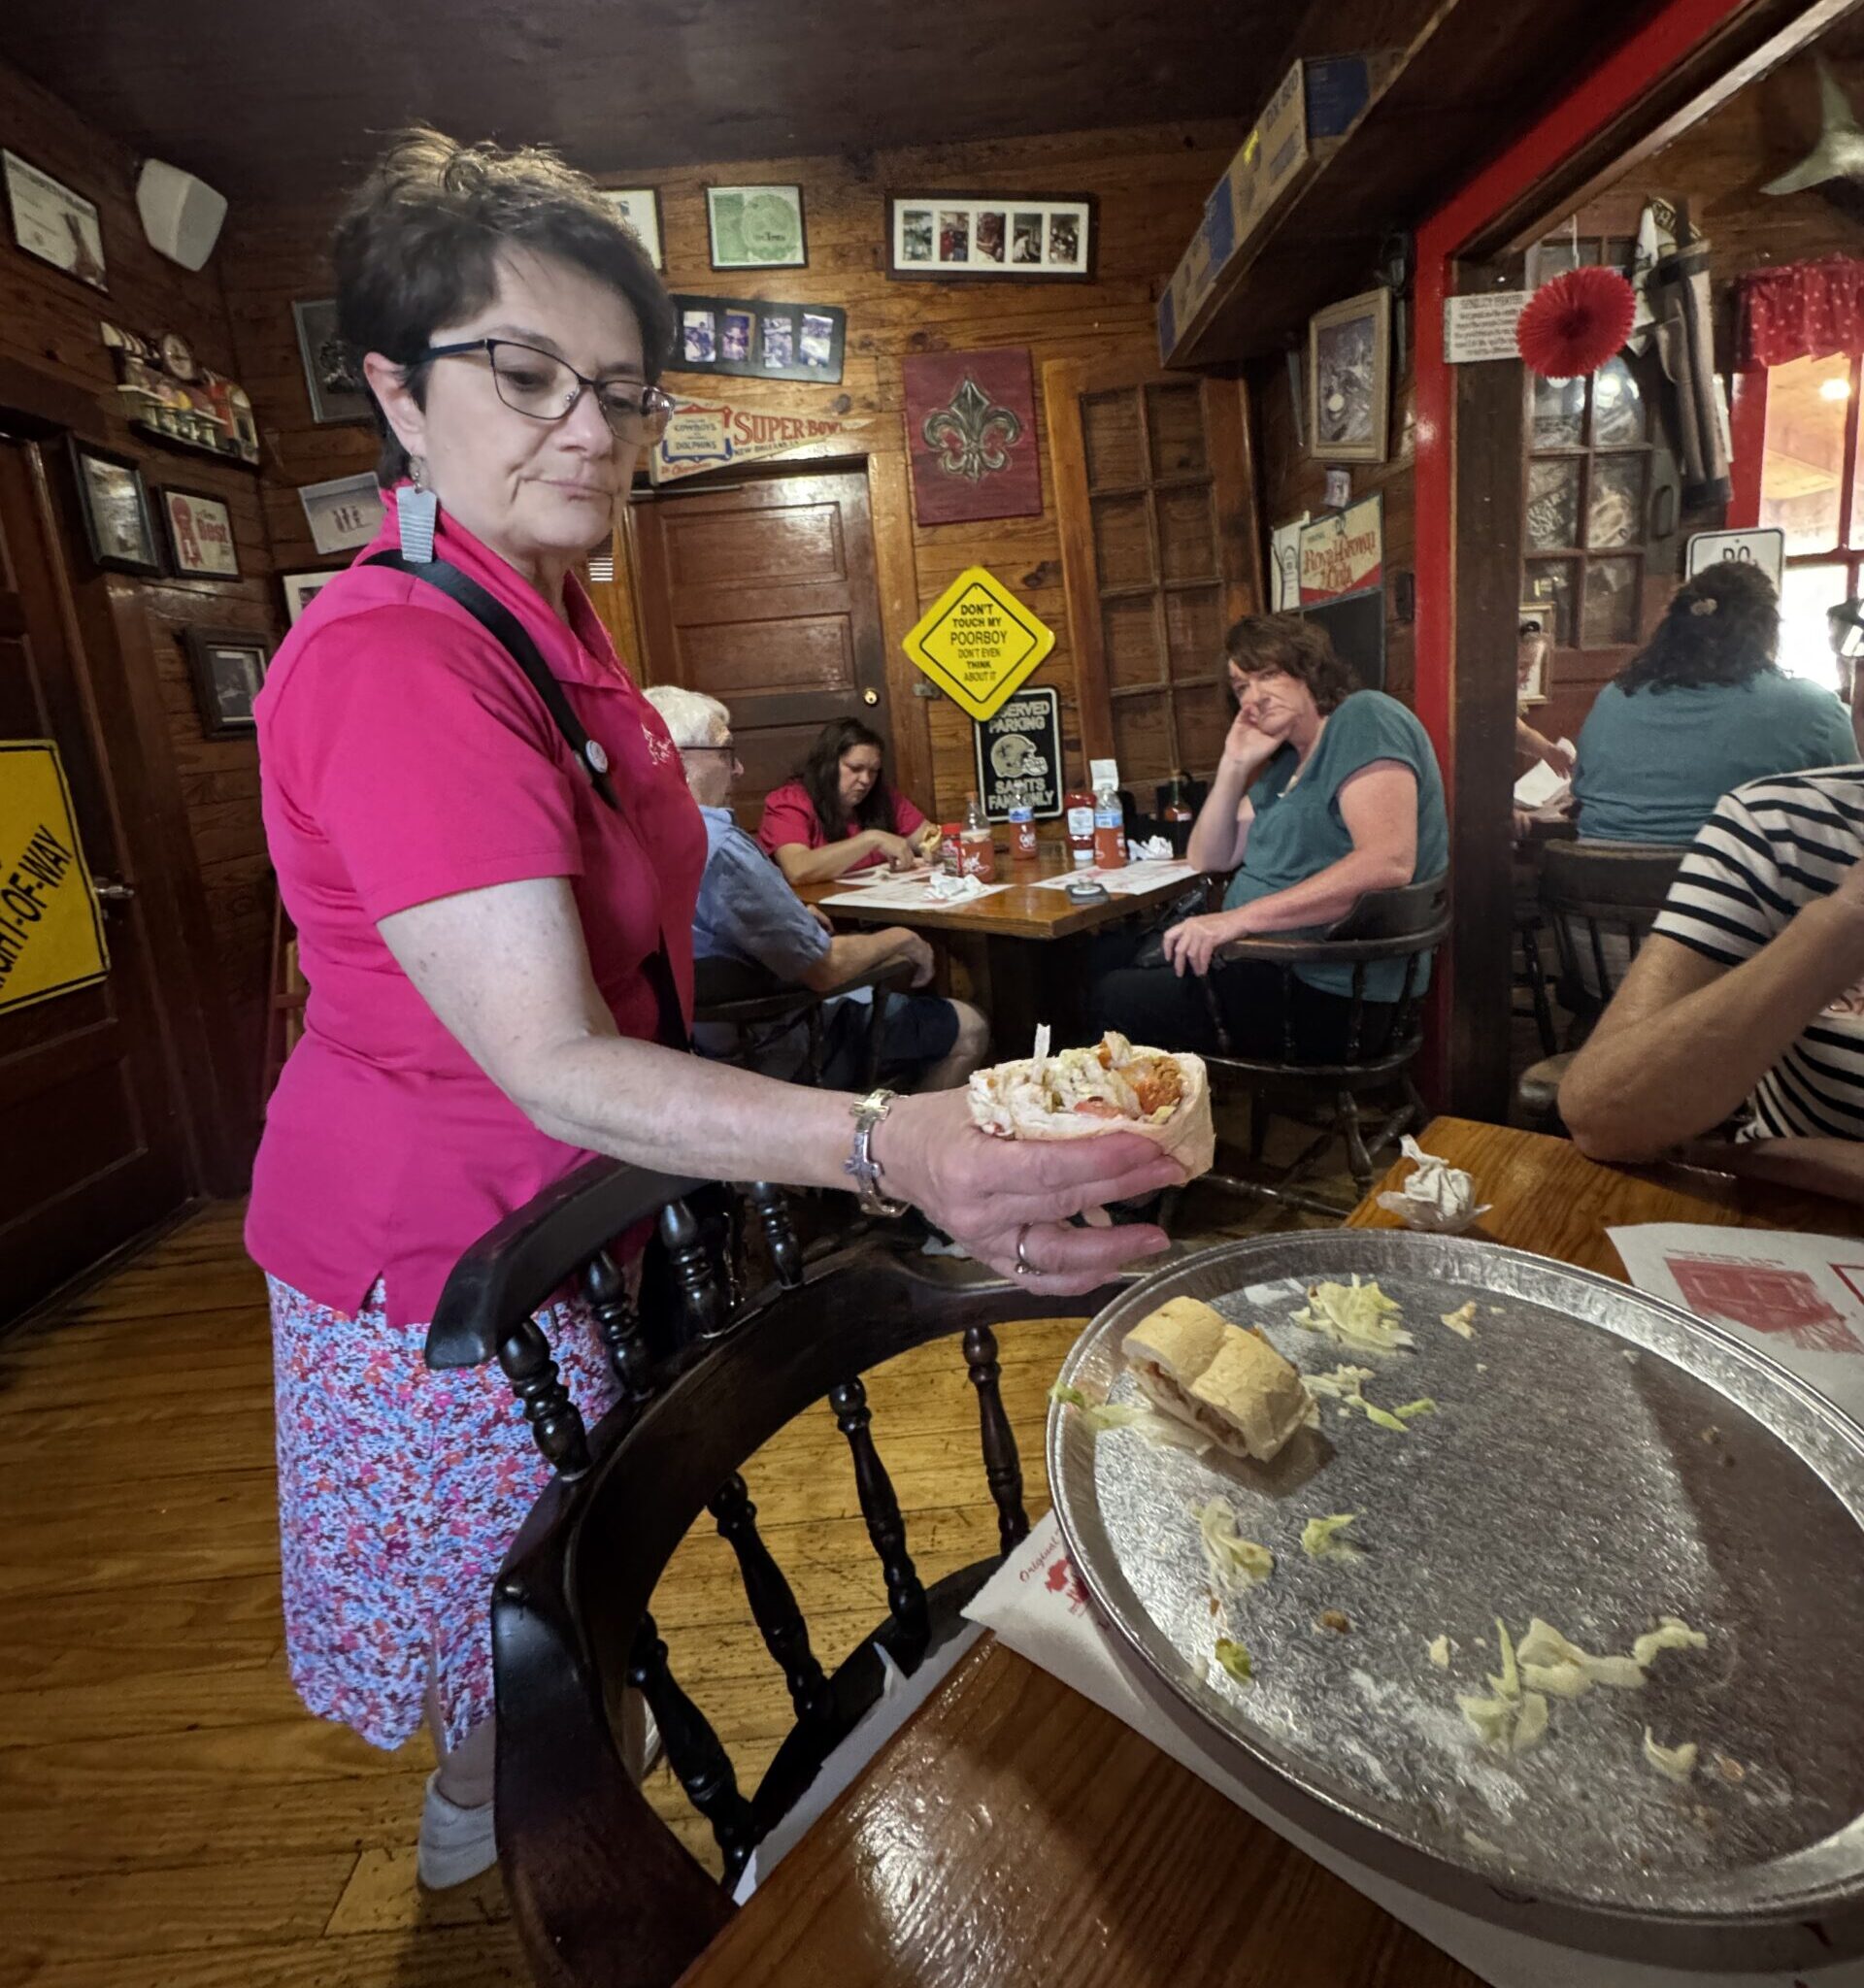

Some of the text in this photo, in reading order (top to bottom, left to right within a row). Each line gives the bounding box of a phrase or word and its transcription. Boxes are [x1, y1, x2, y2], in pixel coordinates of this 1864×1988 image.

[733, 412, 805, 446] SUPER
[960, 603, 994, 615] DON'T
[952, 616, 1002, 629] TOUCH MY
[950, 630, 1008, 646] POORBOY
[957, 646, 1001, 659] DON'T EVEN
[966, 660, 991, 670] THINK
[964, 671, 987, 681] ABOUT
[988, 714, 1047, 734] PARKING
[995, 777, 1046, 794] SANTS
[1019, 1536, 1059, 1582] Original
